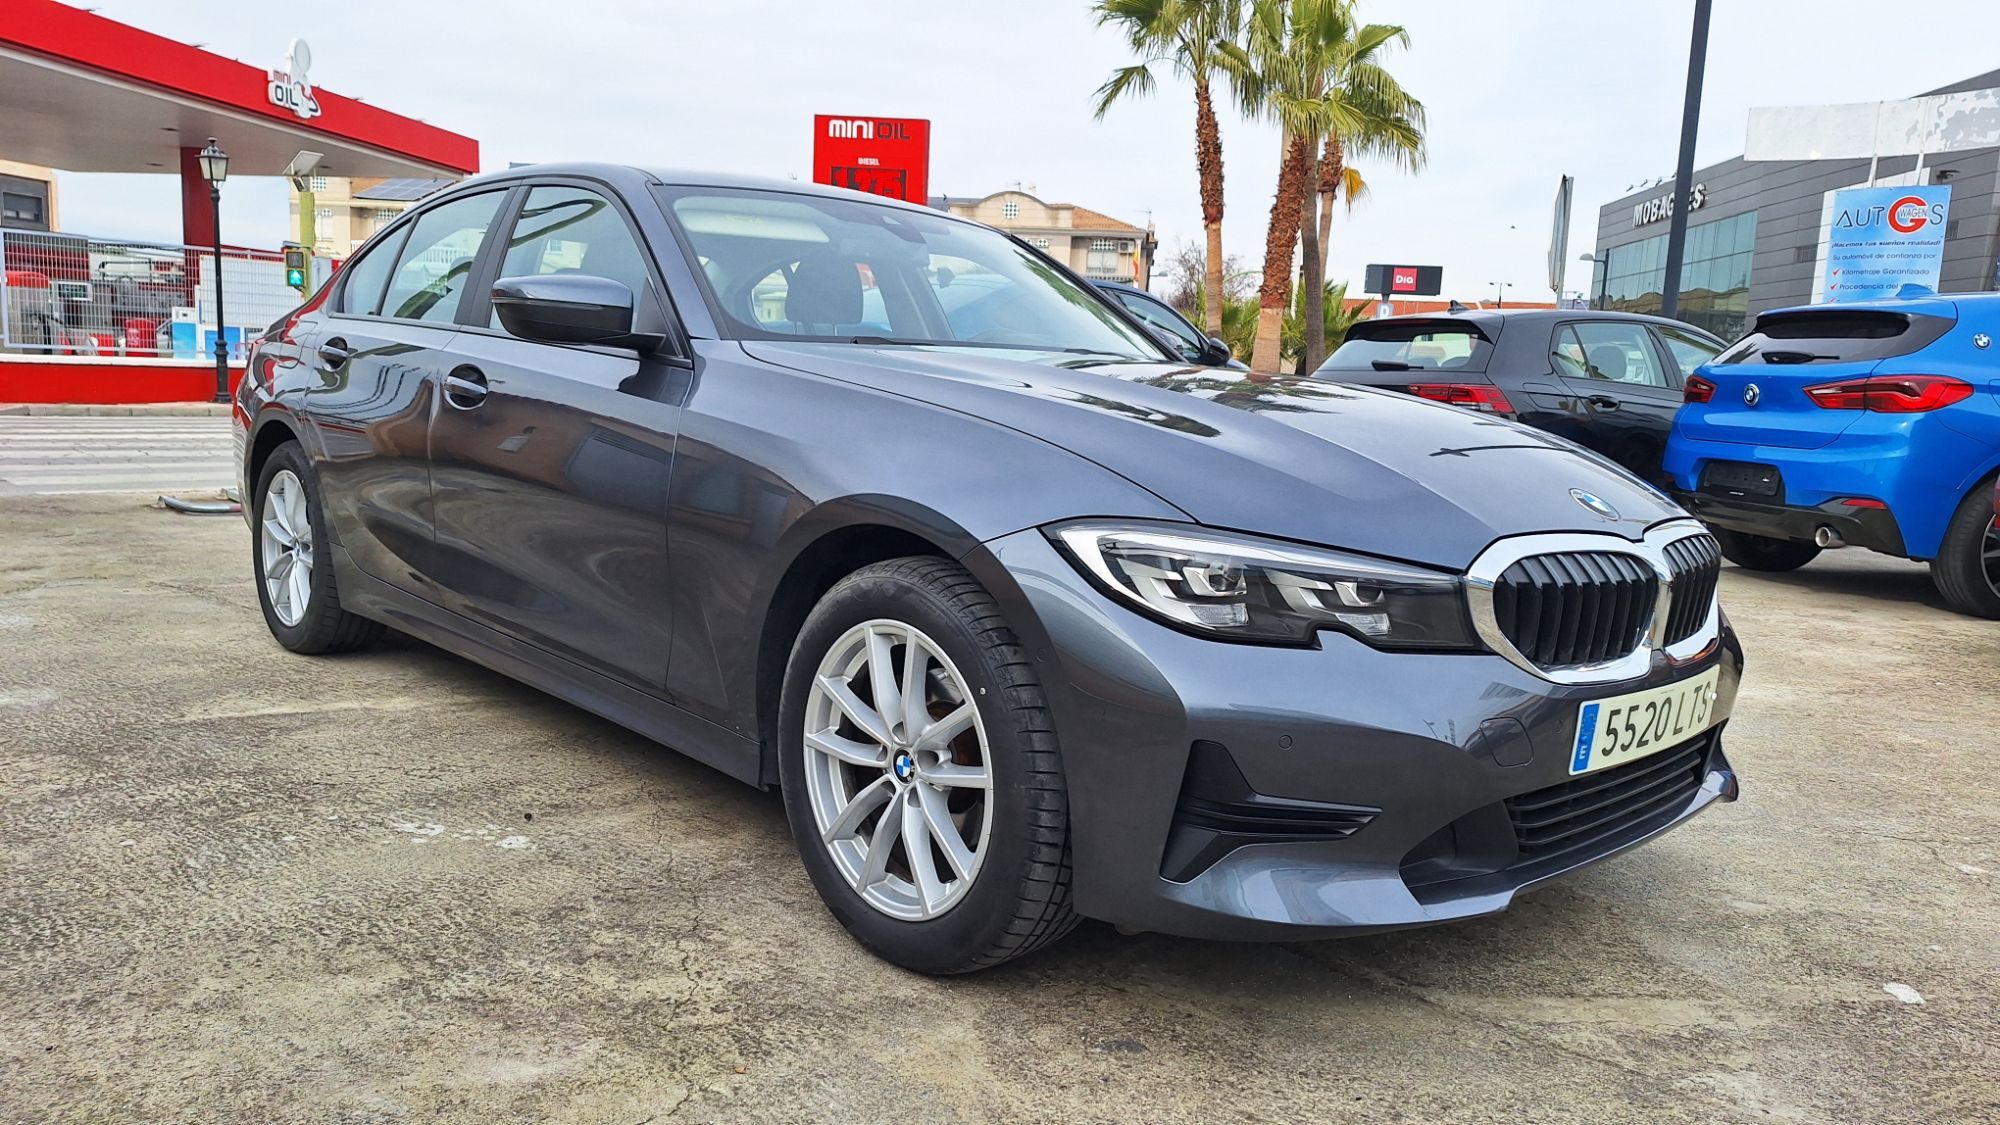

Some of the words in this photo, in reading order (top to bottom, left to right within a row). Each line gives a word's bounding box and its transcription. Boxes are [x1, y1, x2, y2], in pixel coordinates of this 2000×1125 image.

[275, 84, 299, 107] OIL
[877, 121, 910, 140] OIL
[857, 157, 880, 166] DIESEL
[1886, 252, 1922, 260] confianza
[1923, 253, 1937, 261] por
[1882, 267, 1930, 276] Garantizado
[1839, 283, 1884, 291] Procedencia
[1885, 282, 1899, 290] del
[1601, 696, 1673, 757] 5520
[1673, 680, 1711, 736] LTS
